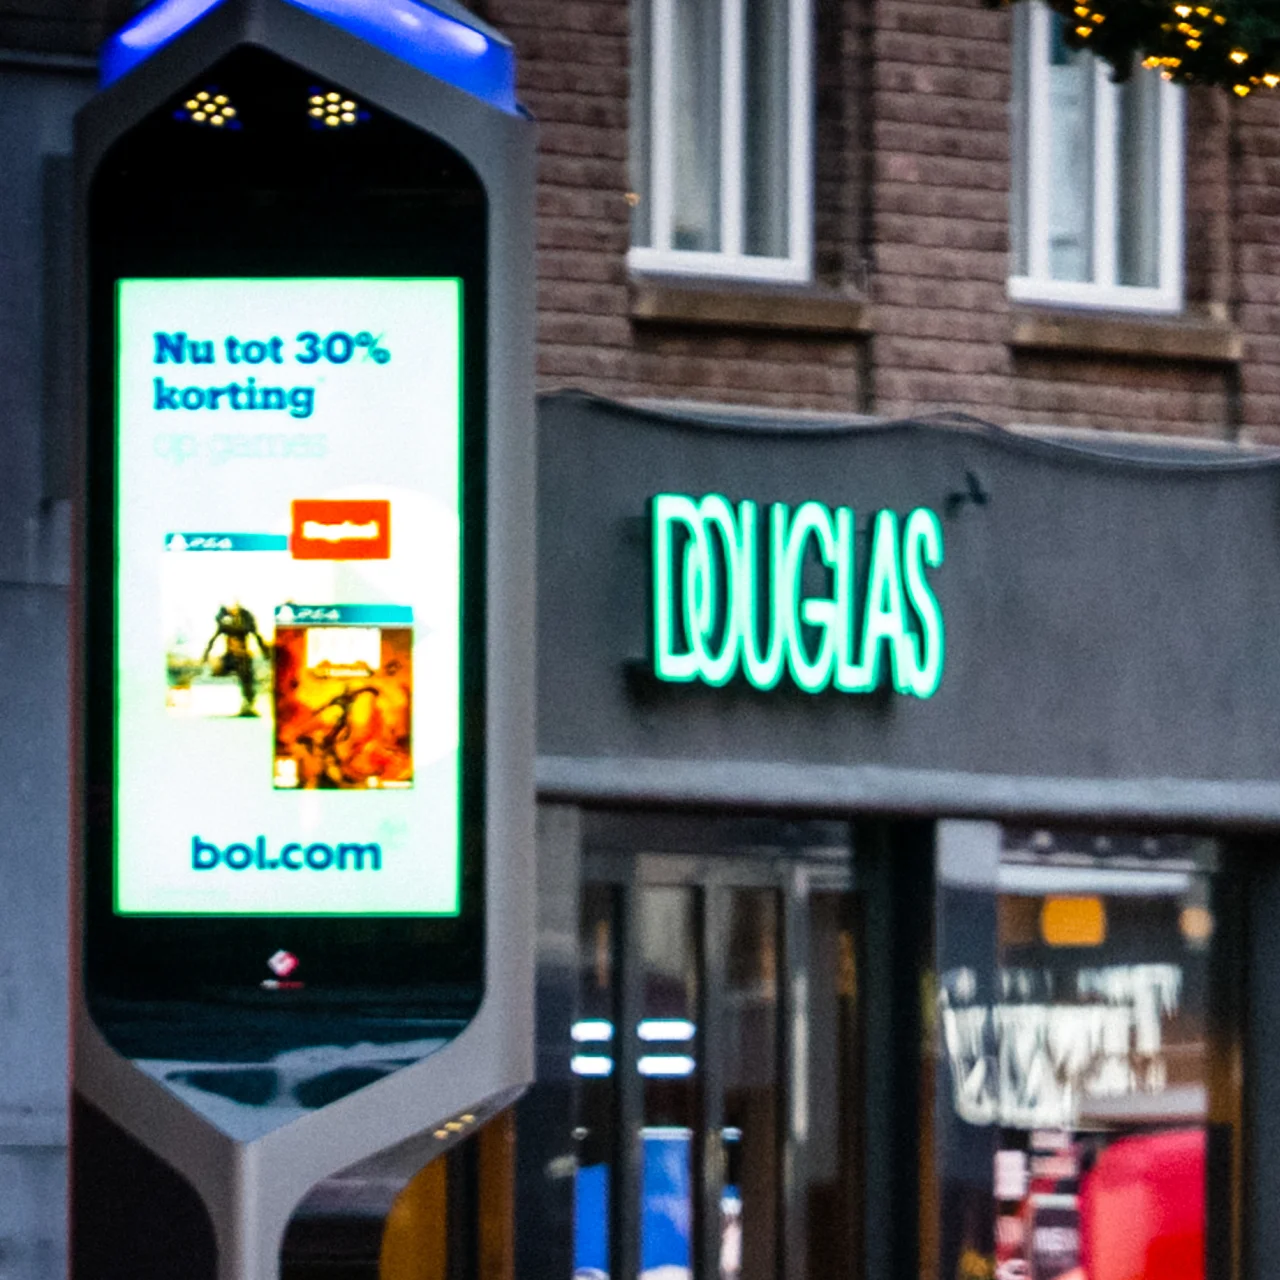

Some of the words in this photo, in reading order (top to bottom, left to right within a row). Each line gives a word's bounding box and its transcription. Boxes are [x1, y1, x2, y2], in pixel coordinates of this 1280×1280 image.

[153, 331, 216, 365] Nu
[224, 335, 284, 364] tot
[295, 331, 391, 364] 30%
[153, 376, 315, 419] korting
[653, 492, 944, 699] DOUGLAS
[191, 834, 382, 872] bol.com
